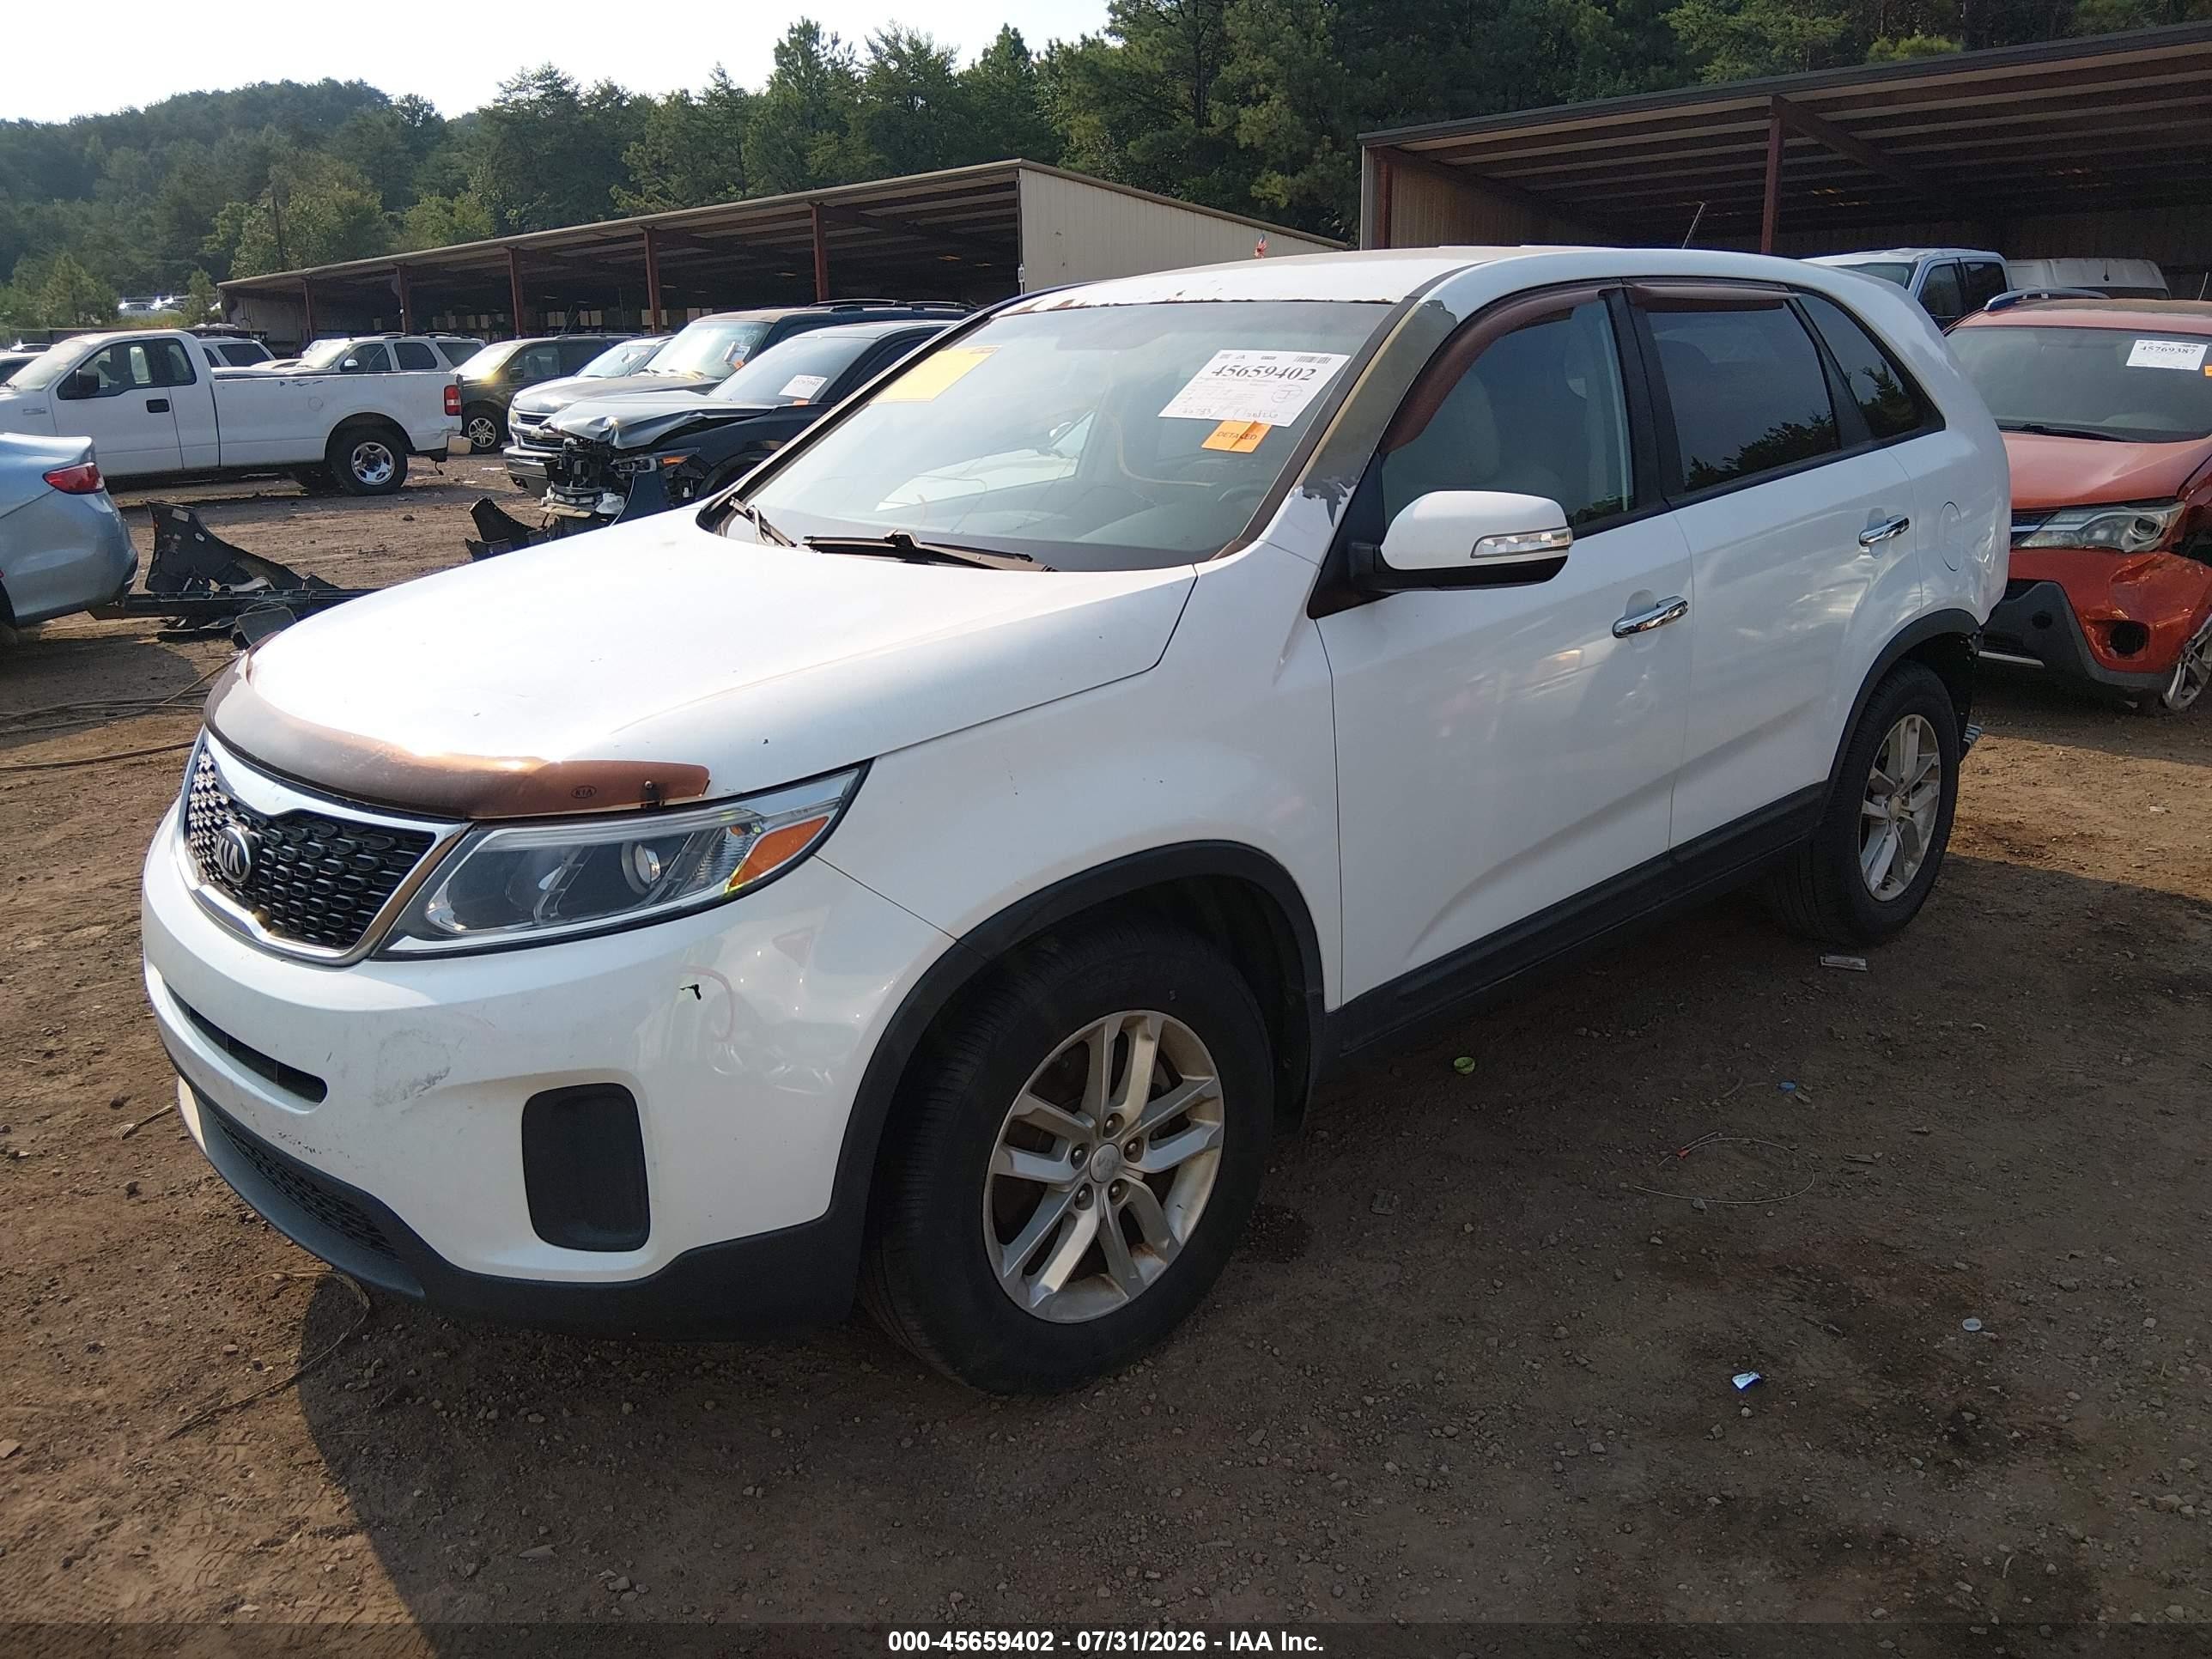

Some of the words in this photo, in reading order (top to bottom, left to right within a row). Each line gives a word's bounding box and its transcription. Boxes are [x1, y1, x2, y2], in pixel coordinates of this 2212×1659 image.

[1211, 364, 1318, 381] 45659402
[575, 787, 594, 798] KIA
[216, 833, 241, 875] KIA
